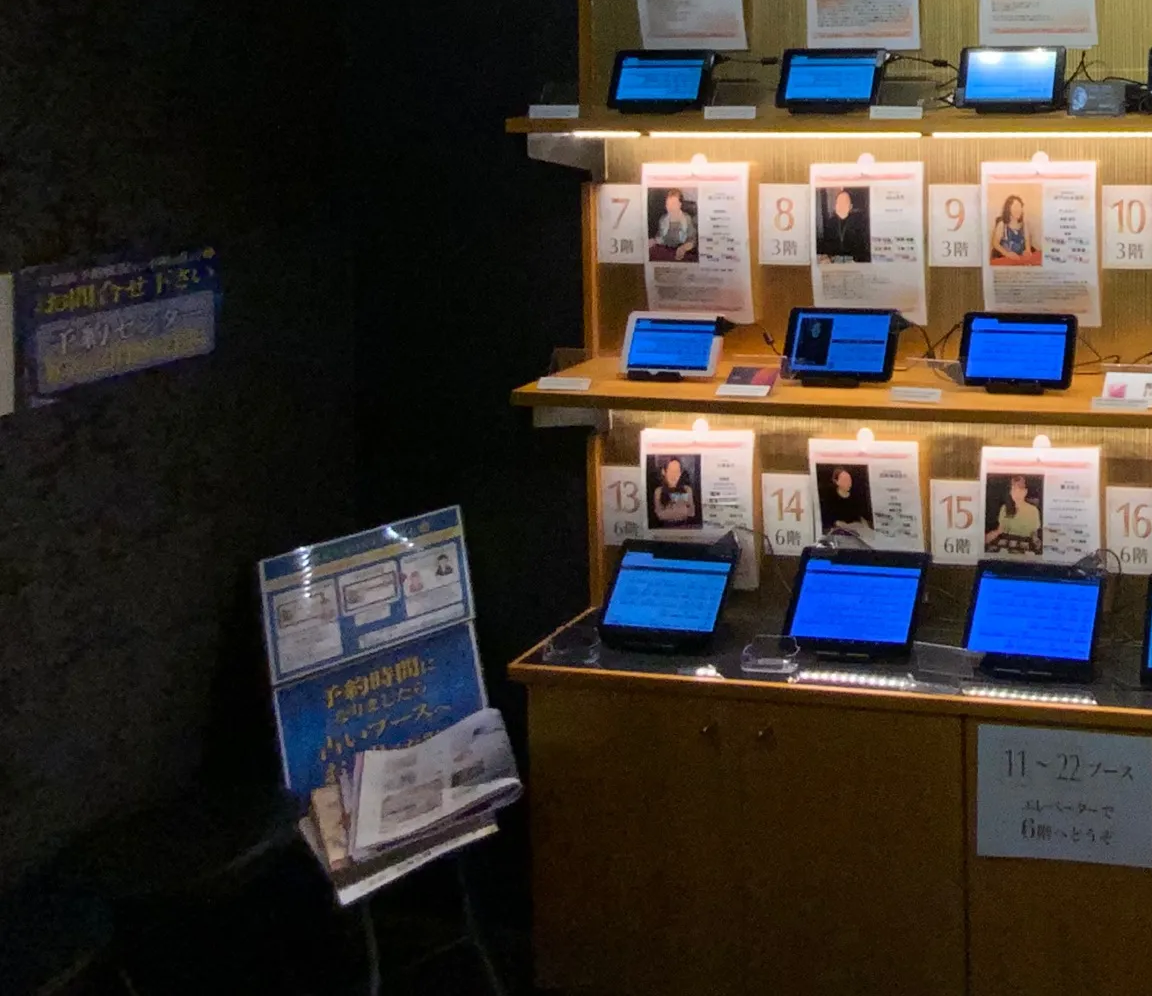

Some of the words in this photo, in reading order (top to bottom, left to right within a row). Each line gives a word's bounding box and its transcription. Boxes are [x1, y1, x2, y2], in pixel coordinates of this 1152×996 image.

[611, 198, 631, 229] 7
[774, 198, 794, 231] 8
[945, 198, 966, 232] 9
[1110, 199, 1147, 234] 10
[611, 238, 633, 254] 3階
[772, 239, 797, 256] 3階
[942, 240, 969, 257] 3階
[1117, 242, 1144, 260] 3階
[607, 480, 640, 514] 13
[771, 488, 804, 522] 14
[939, 495, 973, 530] 15
[1115, 503, 1152, 538] 16
[775, 528, 801, 545] 6階
[943, 537, 970, 554] 6階
[1120, 548, 1148, 564] 6階
